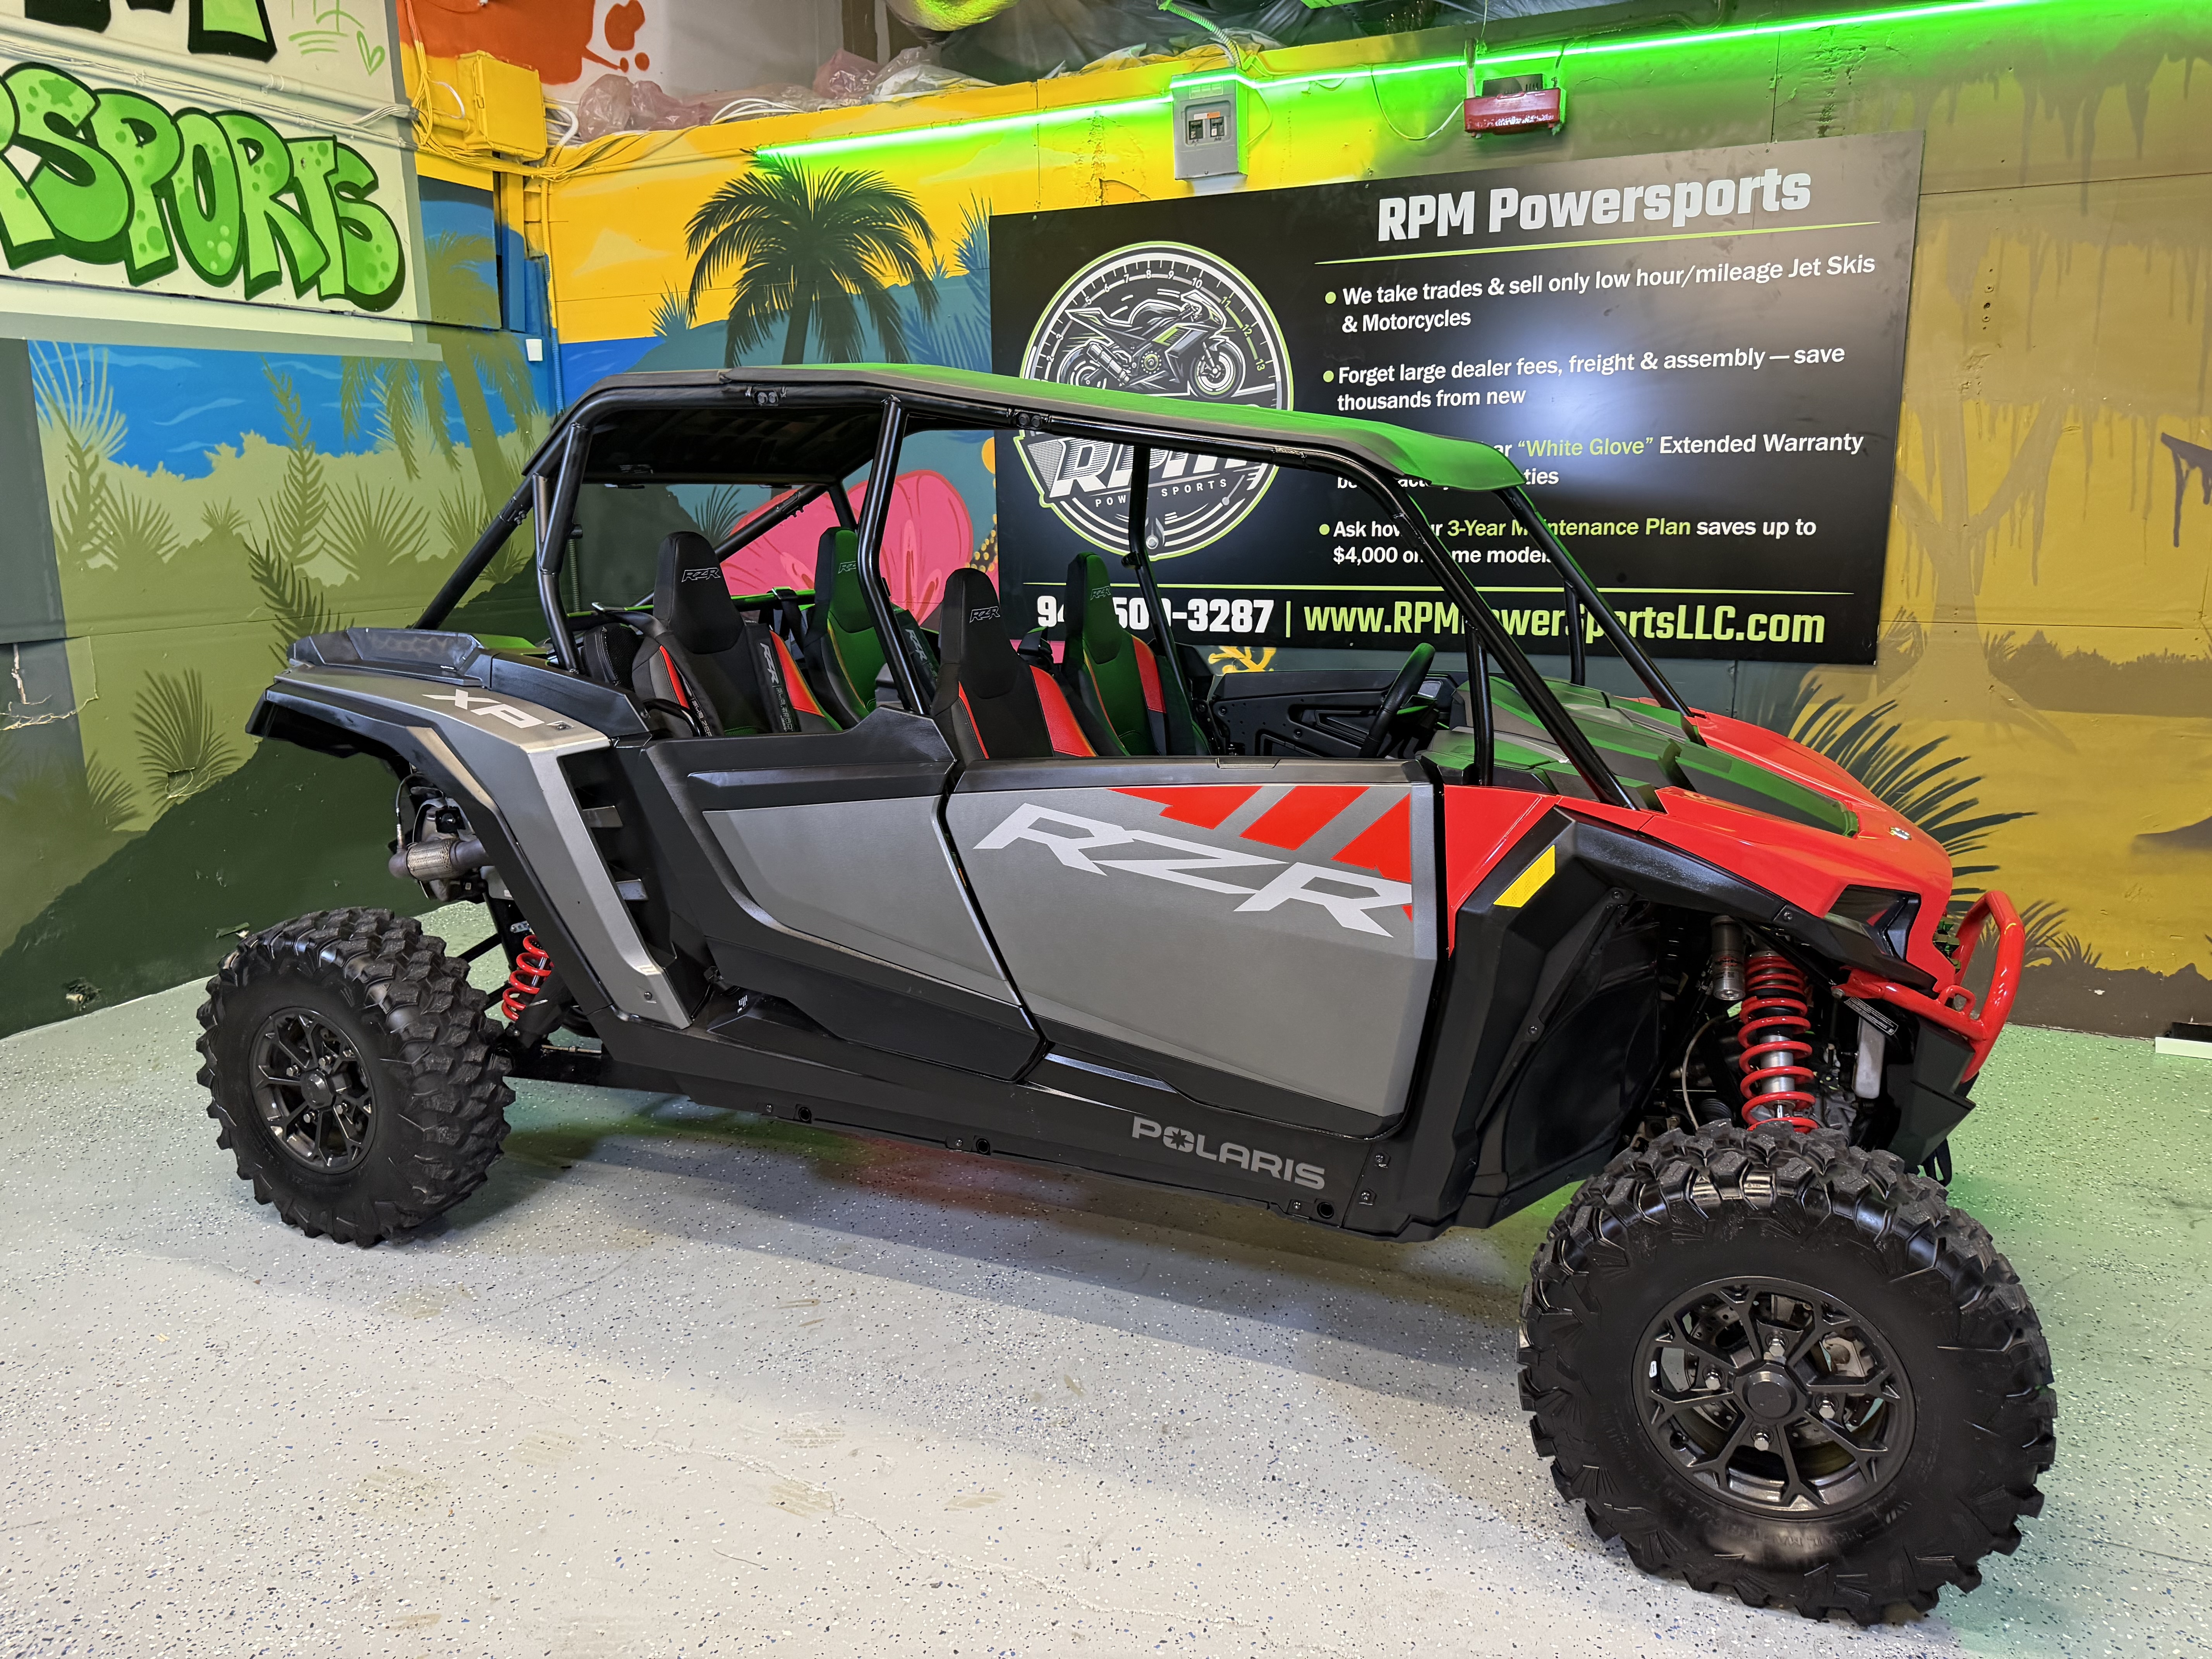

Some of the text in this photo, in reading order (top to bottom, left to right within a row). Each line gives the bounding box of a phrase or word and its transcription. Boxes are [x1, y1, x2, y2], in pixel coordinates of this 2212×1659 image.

[1378, 168, 1811, 241] RPM Powersports
[1343, 254, 1875, 305] We take trades & sell only low hour/mileage Jet Skis
[1085, 296, 1092, 305] 5
[1104, 283, 1110, 292] 6
[1124, 274, 1129, 283] 7
[1146, 270, 1151, 278] 8
[1168, 270, 1174, 279] 9
[1192, 277, 1202, 288] 10
[1242, 324, 1252, 337] 12
[1255, 359, 1265, 371] 13
[1342, 310, 1471, 333] & Motorcycles
[1339, 366, 1395, 386] Forget
[1400, 364, 1446, 383] large
[1451, 360, 1511, 378] dealer
[1516, 358, 1562, 376] fees,
[1569, 352, 1634, 375] freight
[1640, 352, 1658, 369] &
[1664, 348, 1765, 369] assembly
[1794, 348, 1845, 364] save
[1338, 390, 1526, 410] thousands from new
[1518, 439, 1583, 457] “White
[1590, 438, 1653, 455] Glove”
[1660, 435, 1756, 453] Extended
[1763, 434, 1863, 454] Warranty
[1333, 521, 1366, 537] Ask
[1448, 520, 1506, 536] 3-Year
[1511, 519, 1638, 536] Mntenance
[1646, 518, 1690, 535] Plan
[1697, 522, 1756, 535] saves
[1763, 522, 1789, 539] up
[1796, 519, 1816, 535] to
[1333, 546, 1398, 565] $4,000
[1451, 551, 1481, 563] me
[1487, 546, 1551, 563] model
[682, 567, 721, 582] RZR
[969, 606, 1000, 623] RZR
[905, 629, 927, 661] RZR
[760, 643, 779, 684] RZR
[422, 689, 544, 729] XP
[973, 803, 1412, 938] RZR
[1132, 1116, 1325, 1190] POLARIS
